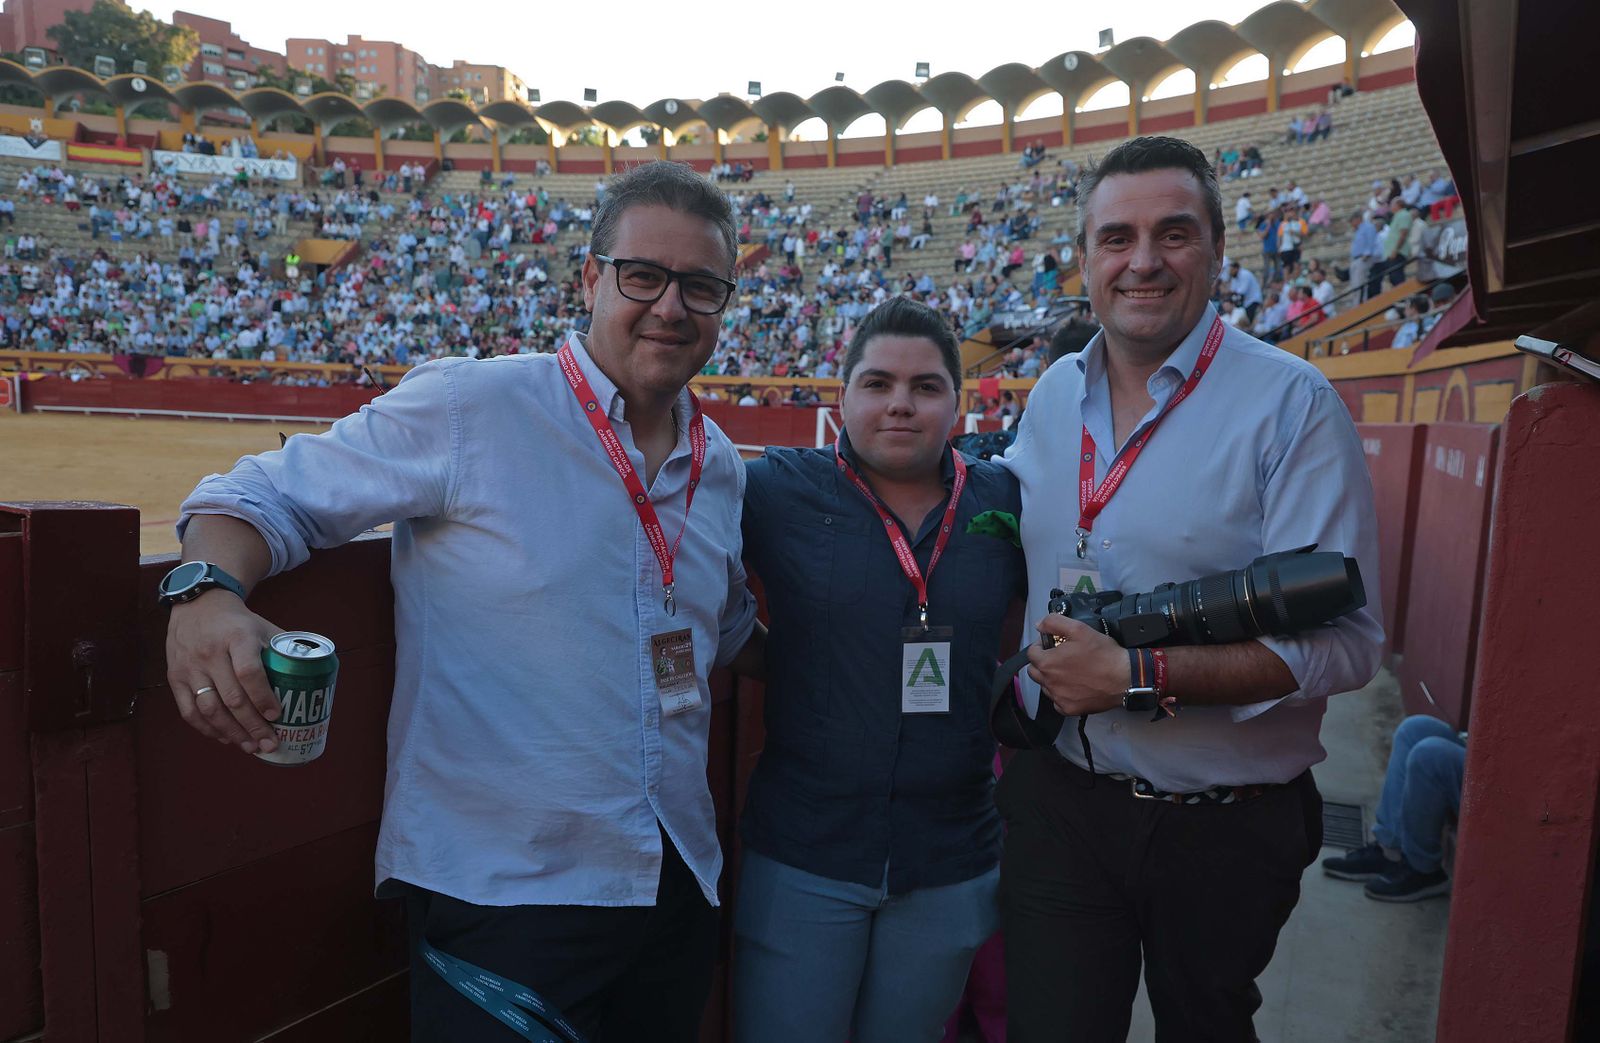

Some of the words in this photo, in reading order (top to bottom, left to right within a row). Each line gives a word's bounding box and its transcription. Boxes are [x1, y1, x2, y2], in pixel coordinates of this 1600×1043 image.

[597, 428, 615, 456] CARMELO
[612, 456, 628, 478] GARCÍA
[605, 428, 632, 472] ESPECTÁCULOS
[1099, 464, 1126, 503] ESPECTÁCULOS
[1104, 459, 1124, 484] CARMELO
[1092, 483, 1107, 503] GARCÍA
[644, 522, 659, 550] CARMELO
[652, 523, 670, 569] ESPECTÁCULOS
[275, 726, 315, 742] ERVEZA
